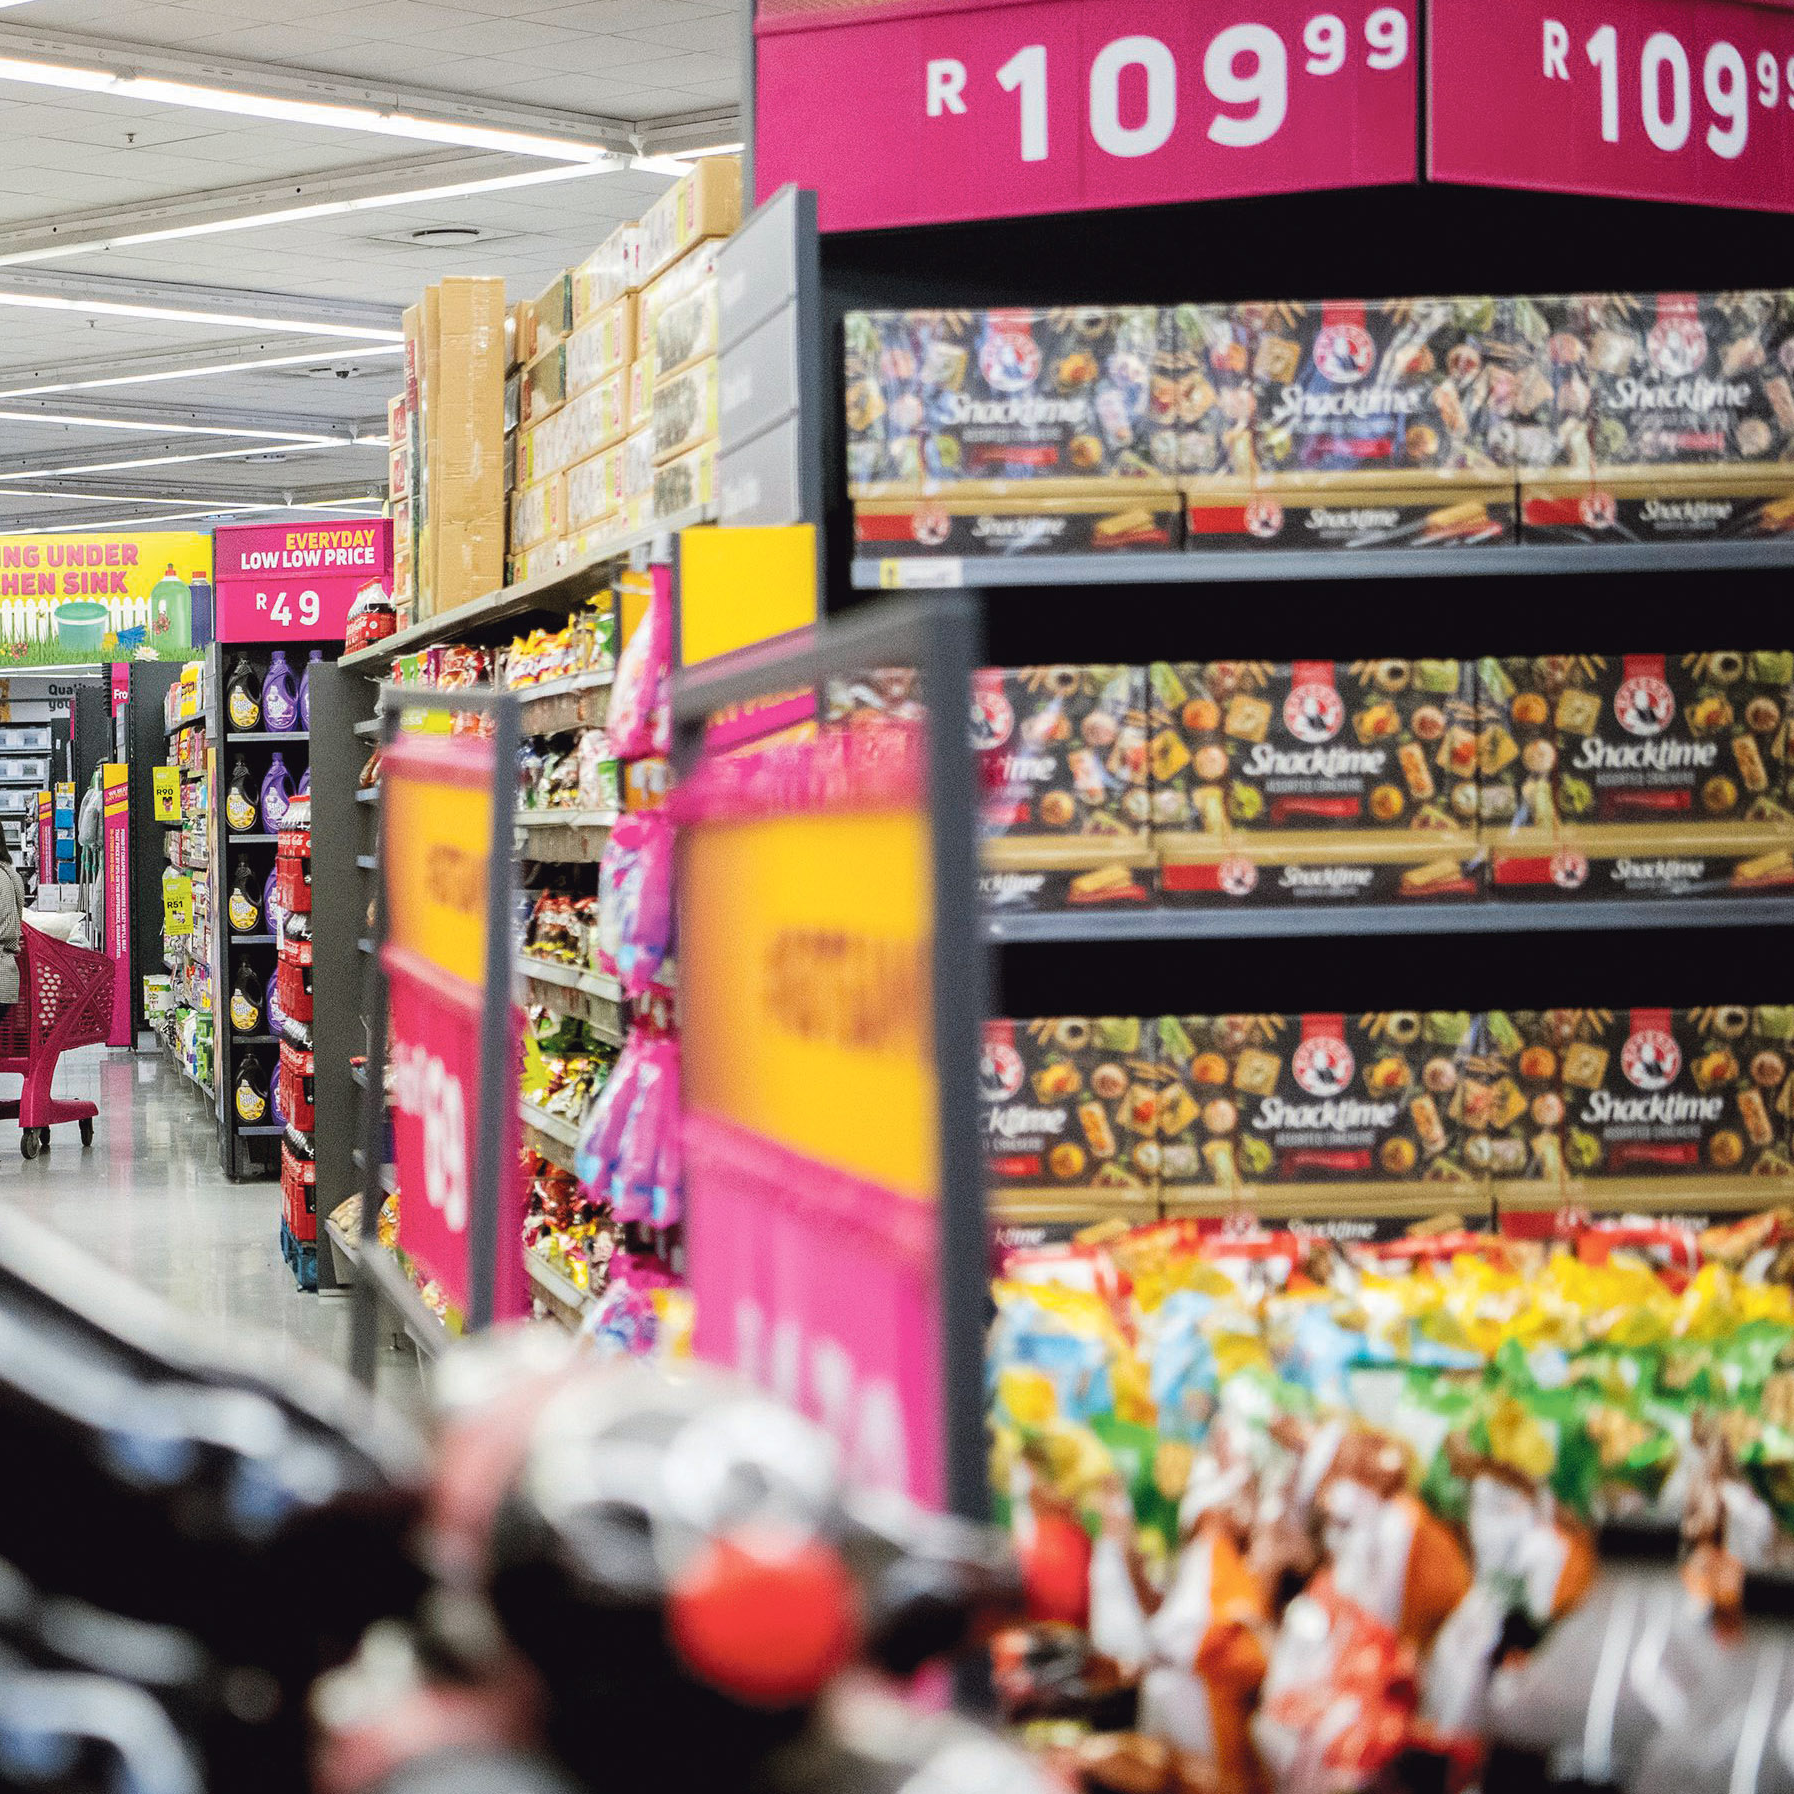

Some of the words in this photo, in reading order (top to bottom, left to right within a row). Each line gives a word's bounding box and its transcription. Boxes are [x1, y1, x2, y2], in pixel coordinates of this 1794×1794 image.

[286, 529, 375, 551] EVERYDAY
[47, 543, 139, 569] UNDER
[241, 551, 281, 570] LOW
[282, 550, 322, 569] LOW
[324, 547, 375, 566] PRICE
[63, 571, 128, 595] SINK
[157, 788, 174, 796] R90
[167, 901, 183, 909] R51
